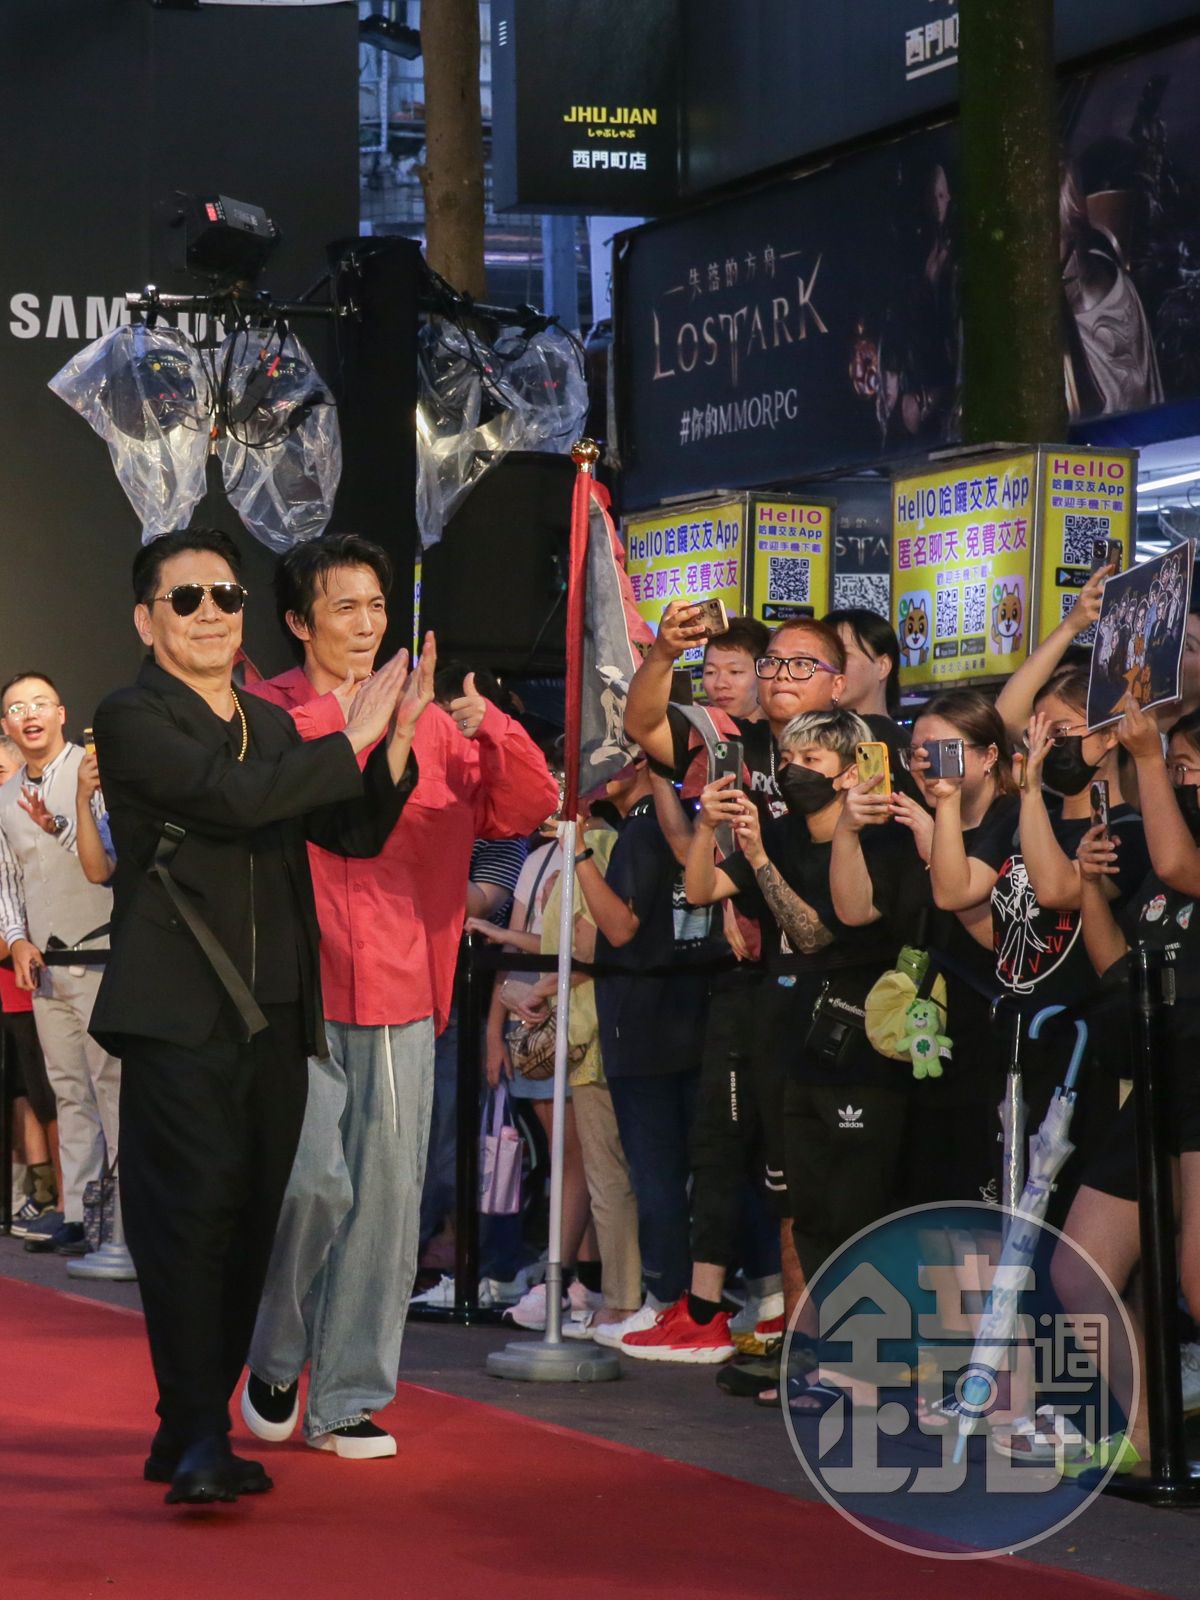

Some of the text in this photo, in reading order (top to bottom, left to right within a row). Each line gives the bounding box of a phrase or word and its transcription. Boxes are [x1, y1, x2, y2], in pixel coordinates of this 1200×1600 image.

[564, 106, 657, 125] JHU JIAN
[572, 150, 646, 170] 西門町店
[1052, 496, 1123, 512] 歡迎手機下載
[898, 518, 1027, 570] 匿名聊天 免費交友
[686, 559, 738, 593] 免費交友
